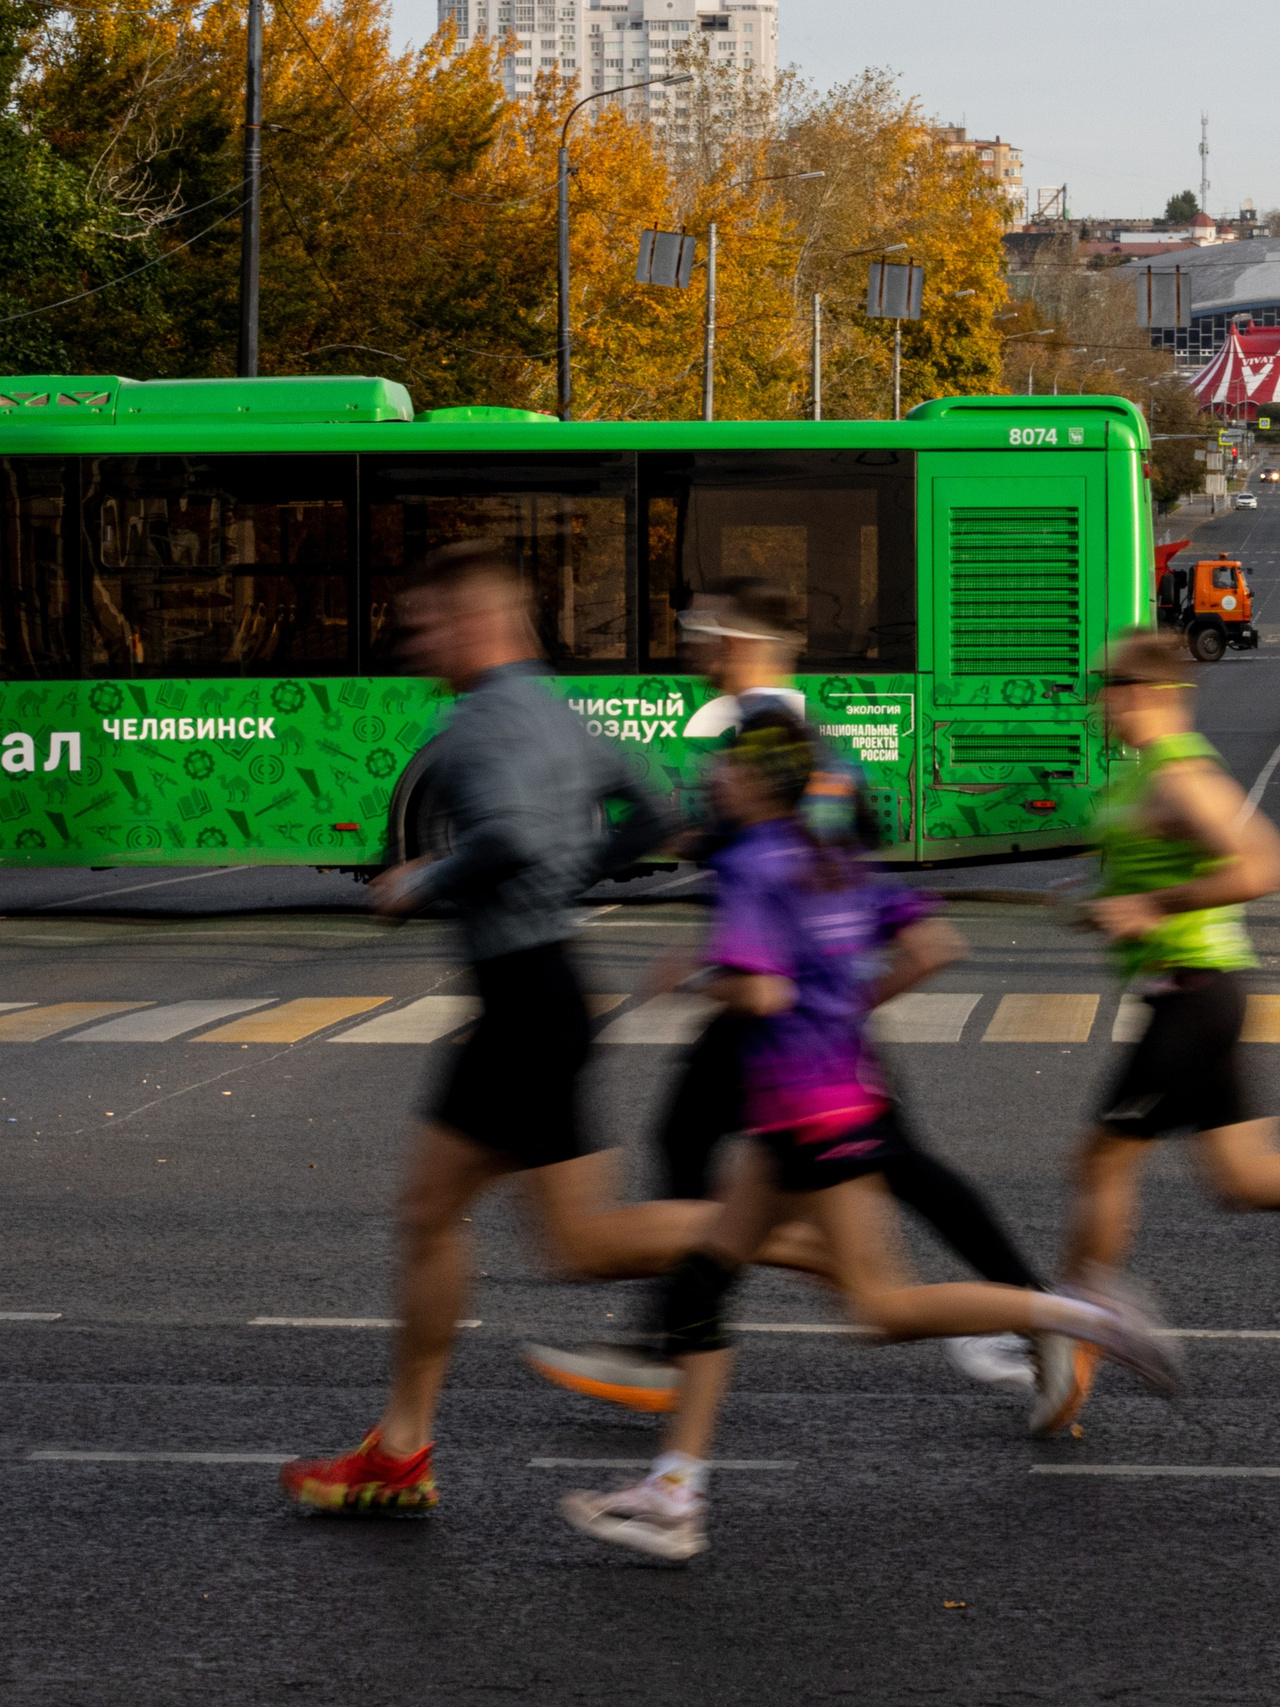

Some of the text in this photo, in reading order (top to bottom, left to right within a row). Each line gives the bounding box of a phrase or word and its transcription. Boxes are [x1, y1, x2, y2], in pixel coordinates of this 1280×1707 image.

[1241, 355, 1276, 366] VIVAT
[1009, 428, 1058, 445] 8074
[102, 716, 276, 740] ЧЕЛЯБИНСК
[580, 719, 678, 743] оздух
[819, 724, 898, 737] НАЦИОНАЛЬНЫЕ
[852, 736, 898, 749] ПРОЕКТЫ
[860, 749, 899, 761] РОССИИ
